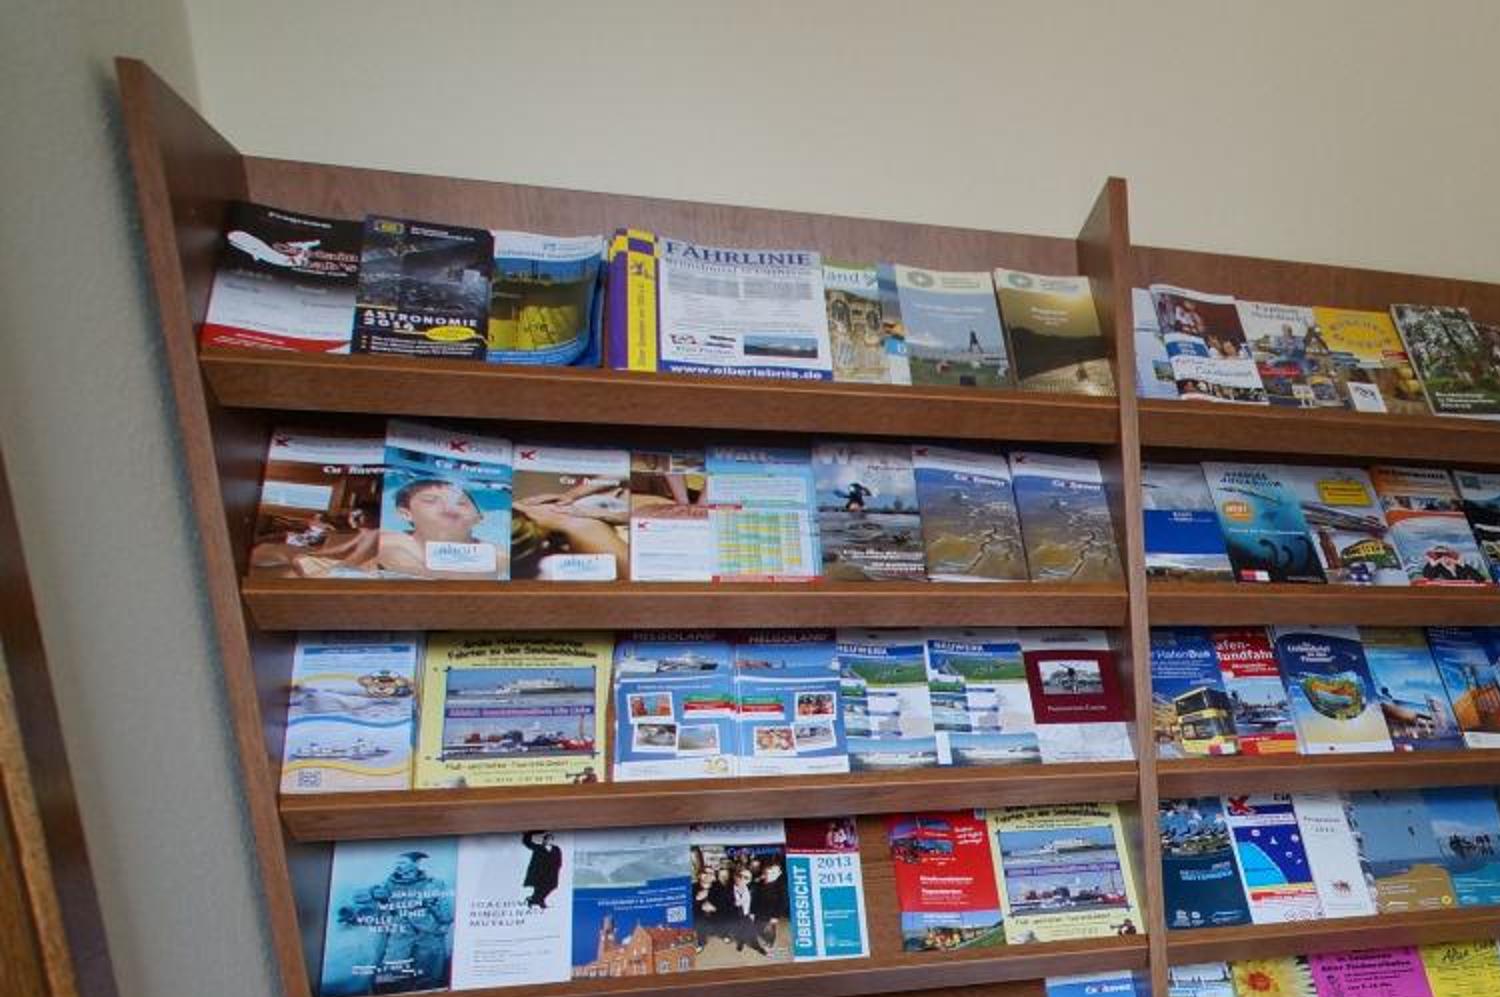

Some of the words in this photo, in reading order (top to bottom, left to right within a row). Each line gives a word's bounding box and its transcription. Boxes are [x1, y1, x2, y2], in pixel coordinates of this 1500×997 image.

[362, 309, 479, 328] ASTRONOMIE
[817, 857, 852, 868] 2013
[818, 872, 855, 884] 2014
